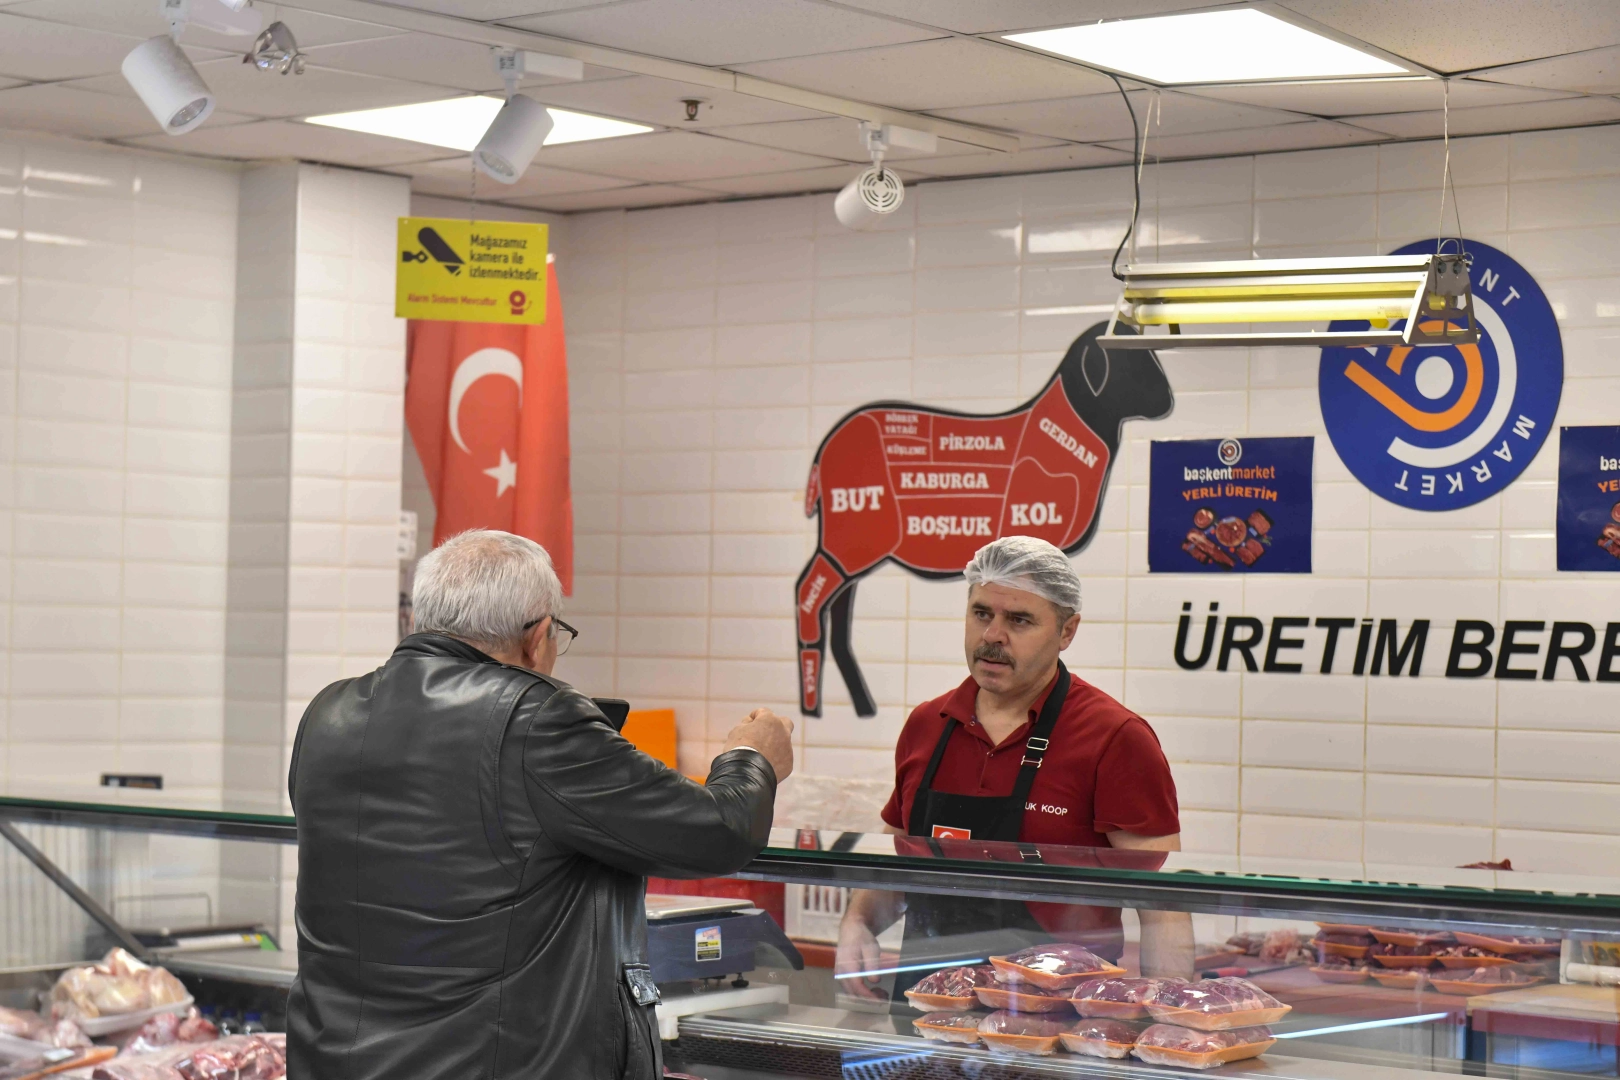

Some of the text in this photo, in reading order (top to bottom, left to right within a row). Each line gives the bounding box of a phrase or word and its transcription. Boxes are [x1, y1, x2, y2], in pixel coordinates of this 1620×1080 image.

[470, 234, 527, 250] Mağazamız
[469, 250, 524, 264] kamera ile
[469, 266, 542, 281] izlenmektedir.
[939, 433, 1006, 451] PİRZOLA
[1039, 417, 1098, 469] GERDAN
[1395, 414, 1536, 496] MARKET
[1600, 455, 1620, 471] ba
[900, 472, 989, 489] KABURGA
[1184, 465, 1275, 483] başkentmarket
[1182, 483, 1278, 502] YERLİ ÜRETİM
[1598, 479, 1620, 493] YE
[831, 486, 884, 513] BUT
[1011, 502, 1062, 526] KOL
[907, 515, 992, 540] BOŞLUK
[1173, 602, 1431, 678] ÜRETİM
[1041, 804, 1068, 816] KOOP
